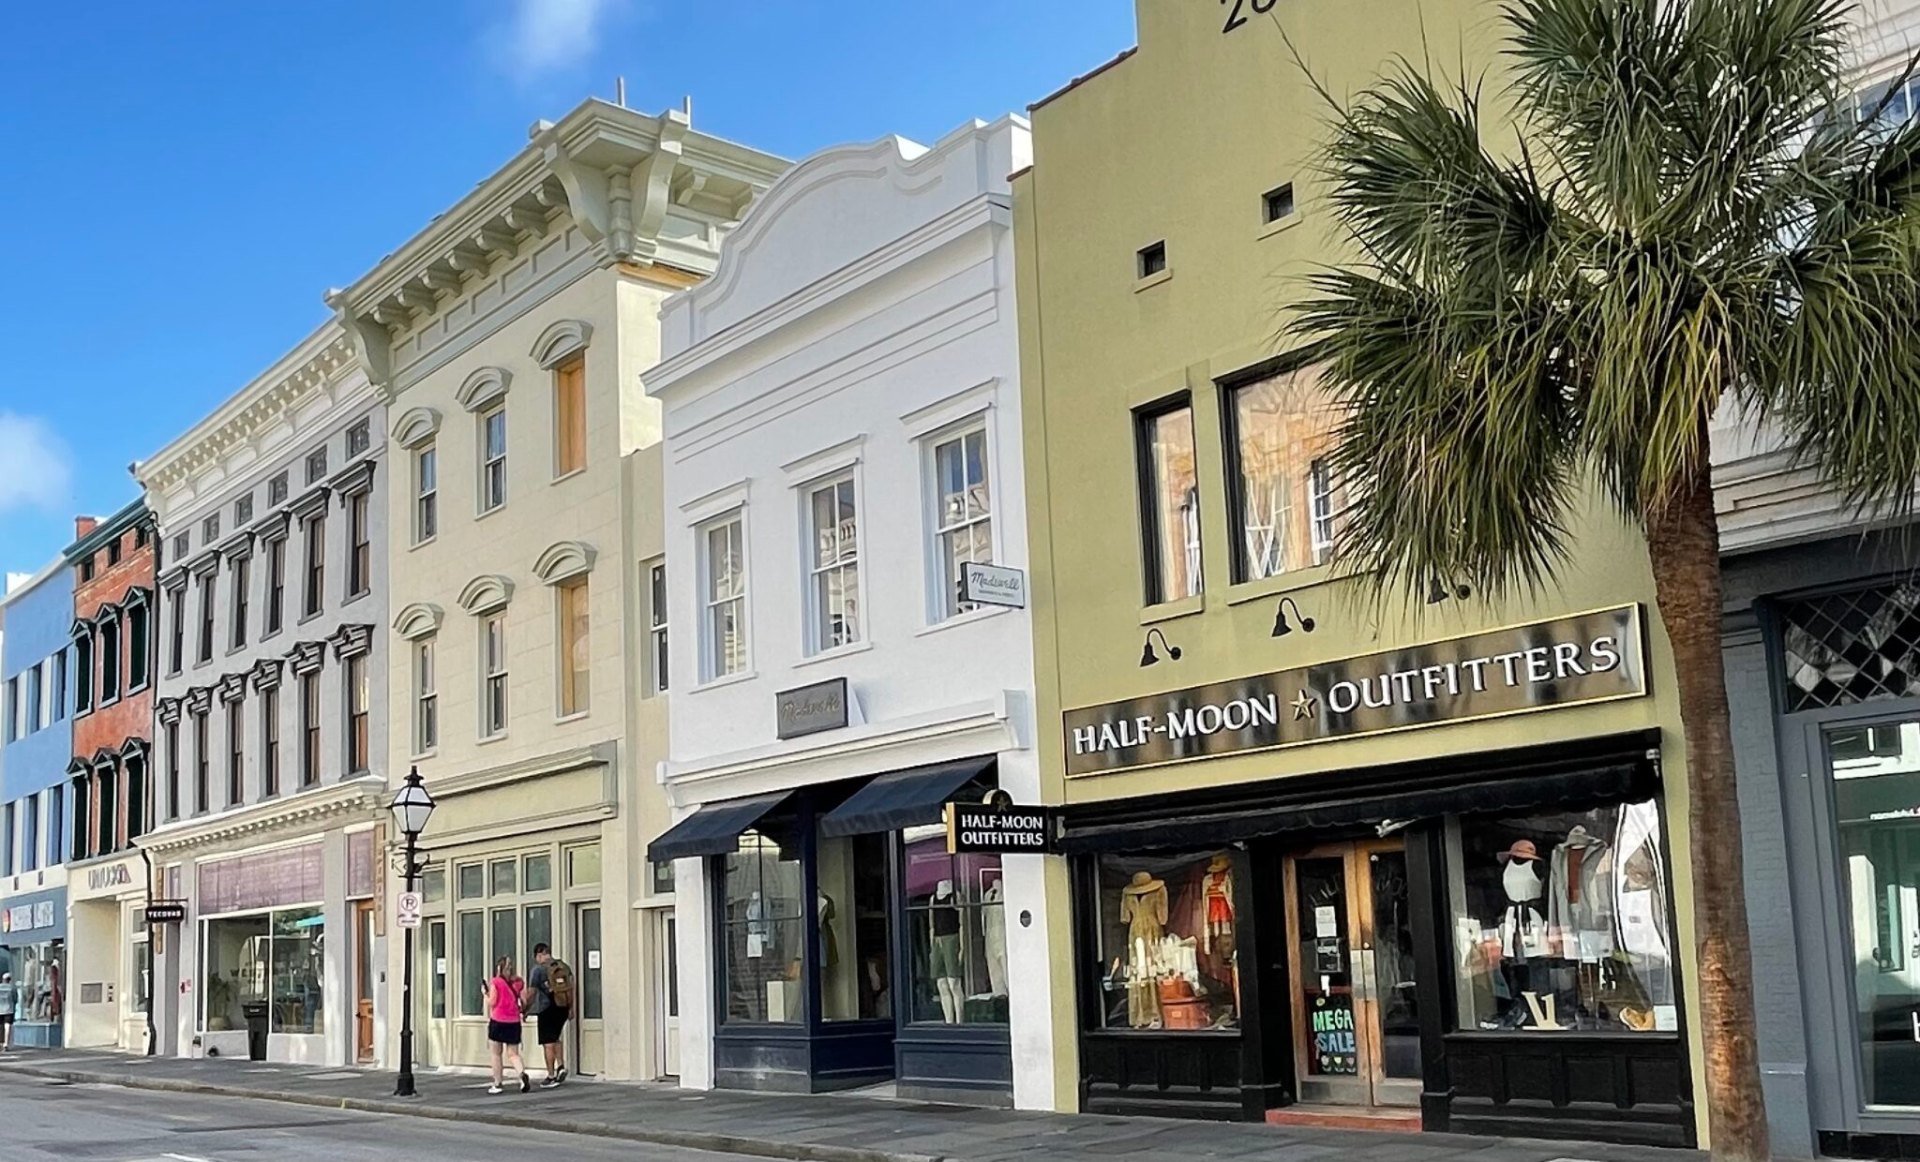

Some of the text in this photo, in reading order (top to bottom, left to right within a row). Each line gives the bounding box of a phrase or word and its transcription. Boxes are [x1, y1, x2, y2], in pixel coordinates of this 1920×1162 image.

[971, 571, 1020, 591] Madewell
[1073, 636, 1621, 756] HALF-MOON OUTFITTERS
[961, 814, 1044, 830] HALF-MOON
[961, 831, 1045, 846] OUTFITTERS
[1312, 1008, 1354, 1032] MEGA
[1316, 1031, 1356, 1053] SALE
